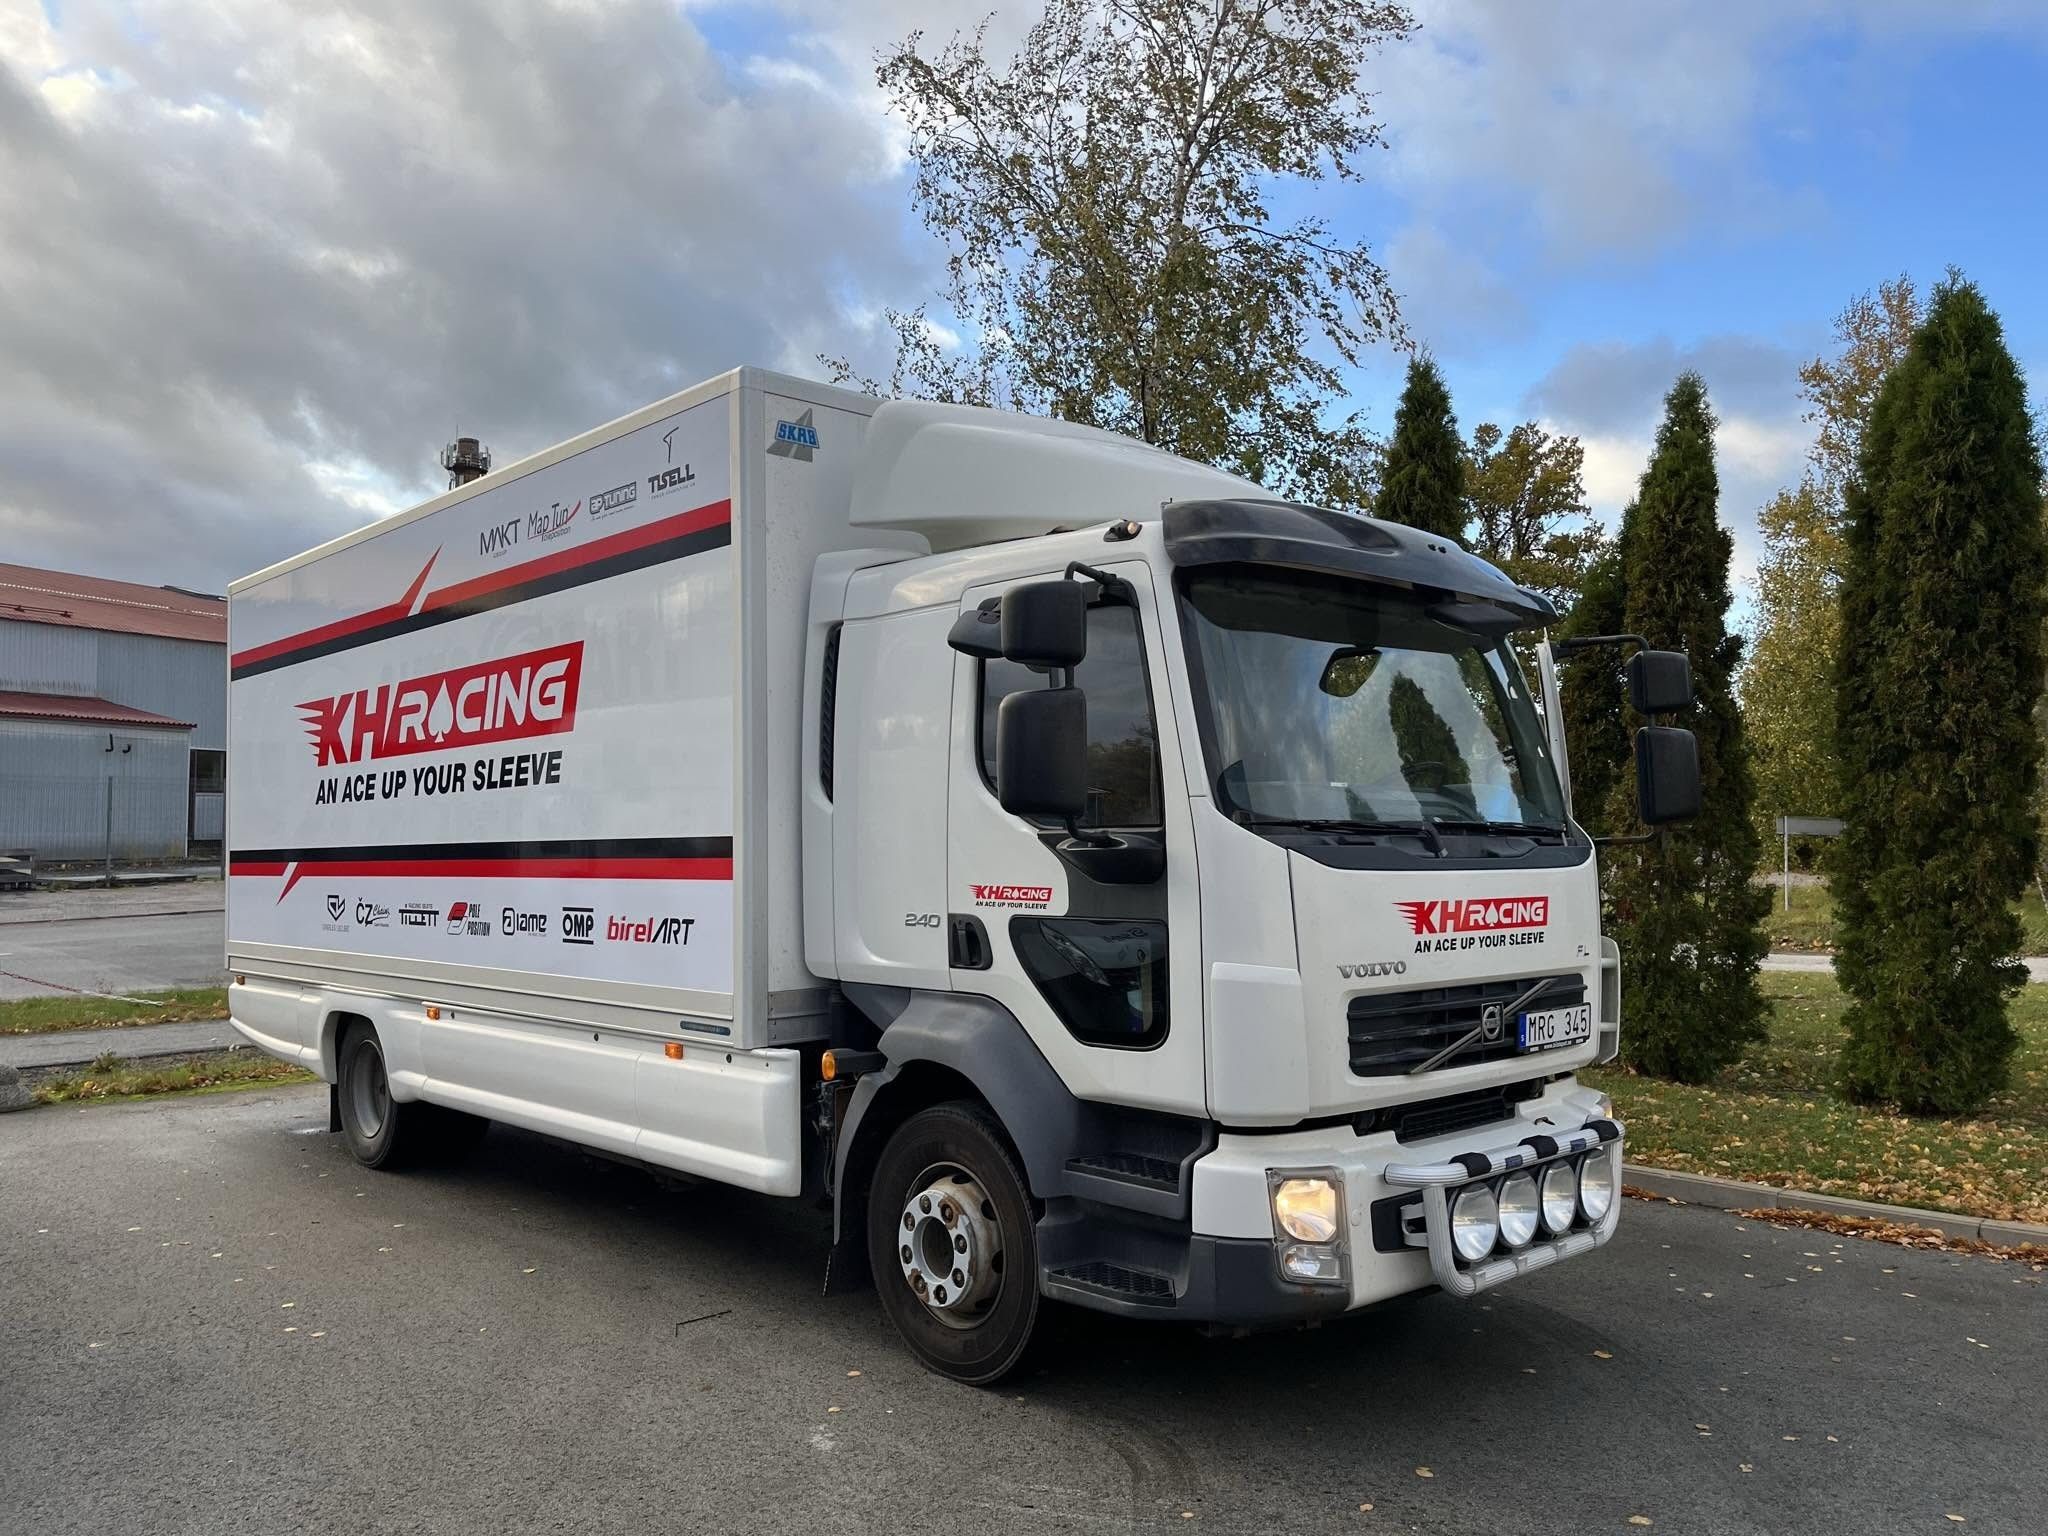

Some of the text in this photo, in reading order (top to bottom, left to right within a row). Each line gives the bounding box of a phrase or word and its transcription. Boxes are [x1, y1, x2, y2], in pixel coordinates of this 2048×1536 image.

[647, 464, 695, 494] TISELL
[527, 509, 550, 538] Map
[551, 503, 570, 531] Tun
[315, 750, 563, 805] AN ACE UP YOUR SLEEVE
[468, 903, 481, 918] POLE
[904, 913, 941, 928] 240
[466, 921, 491, 937] POSITION
[562, 914, 595, 938] OMP
[1414, 931, 1545, 953] AN ACE UP YOUR SLEEVE
[1336, 961, 1407, 979] VOLVO
[1528, 1008, 1587, 1042] MRG 345
